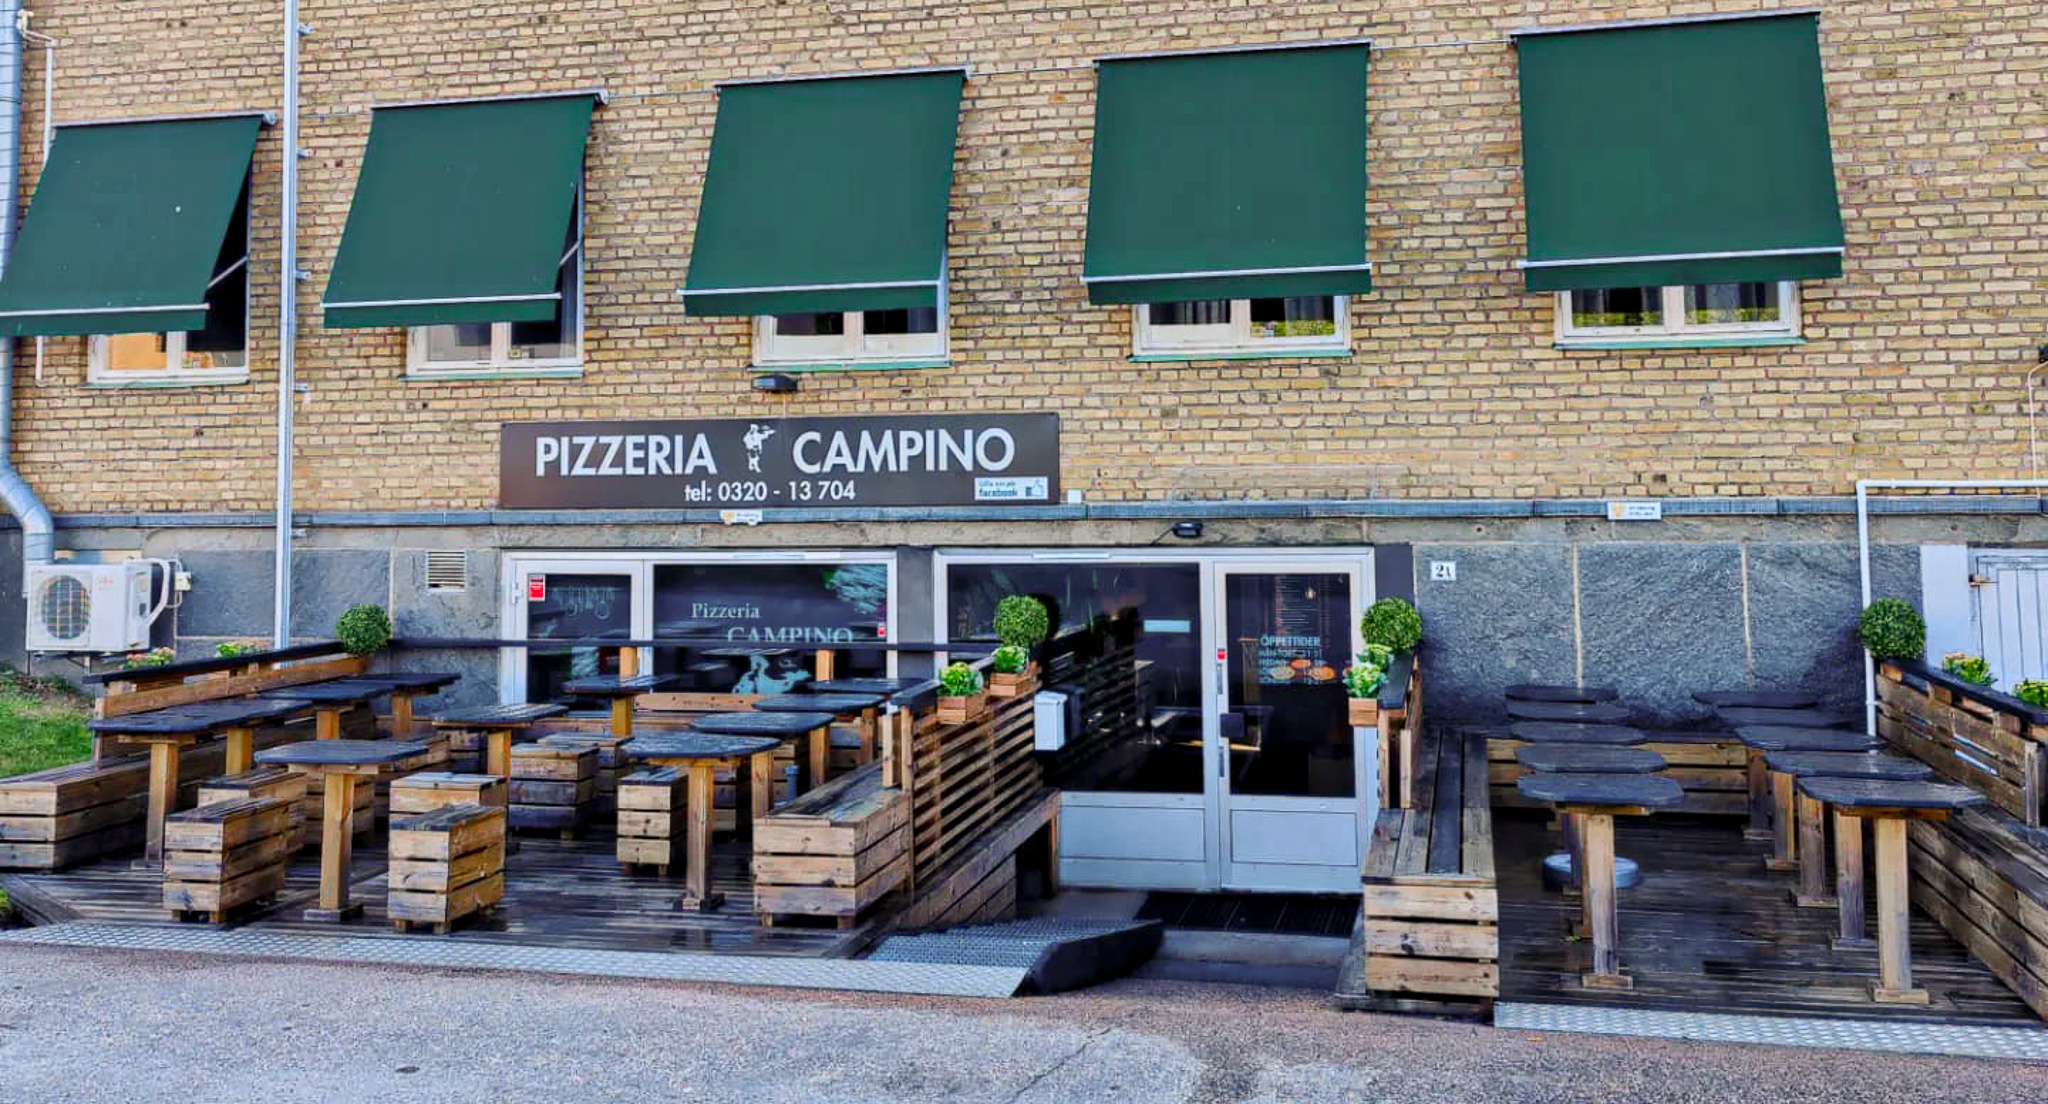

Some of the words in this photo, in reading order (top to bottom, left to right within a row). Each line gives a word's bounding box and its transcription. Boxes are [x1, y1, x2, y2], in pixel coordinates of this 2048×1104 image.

[535, 433, 718, 477] PIZZERIA
[792, 427, 1016, 474] CAMPINO
[684, 480, 712, 502] tel:
[717, 482, 768, 501] 0320
[788, 481, 812, 500] 13
[818, 480, 856, 500] 704
[978, 488, 1018, 497] facebook
[691, 602, 760, 618] Pizzeria
